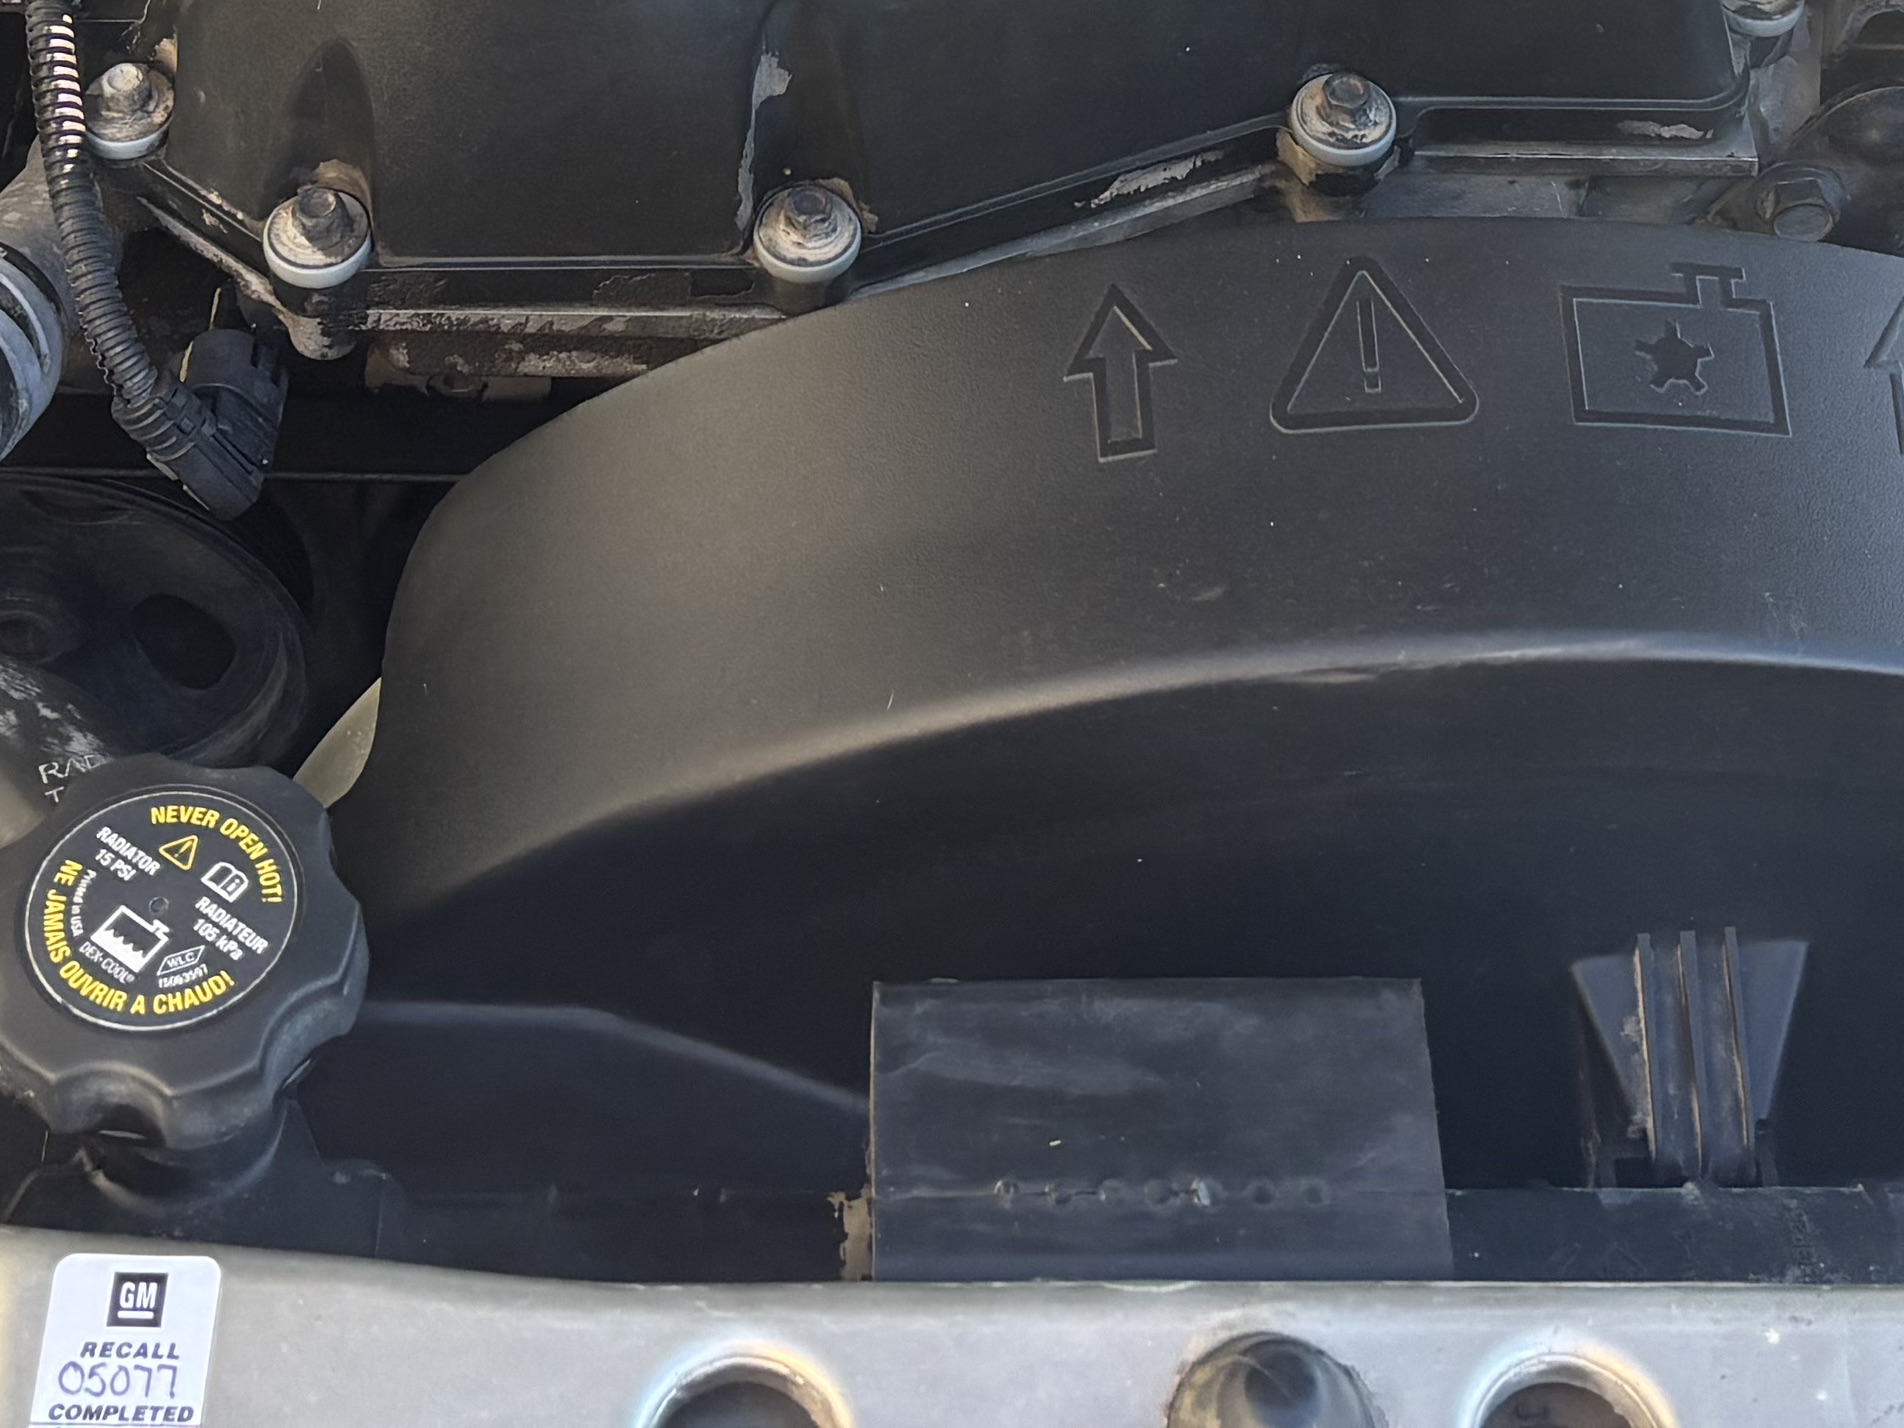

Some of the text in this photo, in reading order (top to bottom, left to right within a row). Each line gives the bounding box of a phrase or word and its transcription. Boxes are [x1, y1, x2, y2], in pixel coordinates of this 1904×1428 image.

[95, 848, 137, 881] 15 PSI
[96, 826, 161, 877] RADIATOR
[150, 805, 284, 905] NEVER OPEN HOT!
[43, 859, 235, 1016] NE JAMAIS OUVRIR A CHAUD!
[70, 916, 84, 937] USA
[192, 918, 245, 962] 105 kPa
[195, 896, 269, 955] RADIATEUR
[166, 952, 196, 968] WLC
[80, 1341, 180, 1360] RECALL
[58, 1360, 178, 1399] 05077
[48, 1403, 194, 1423] COMPLETED
